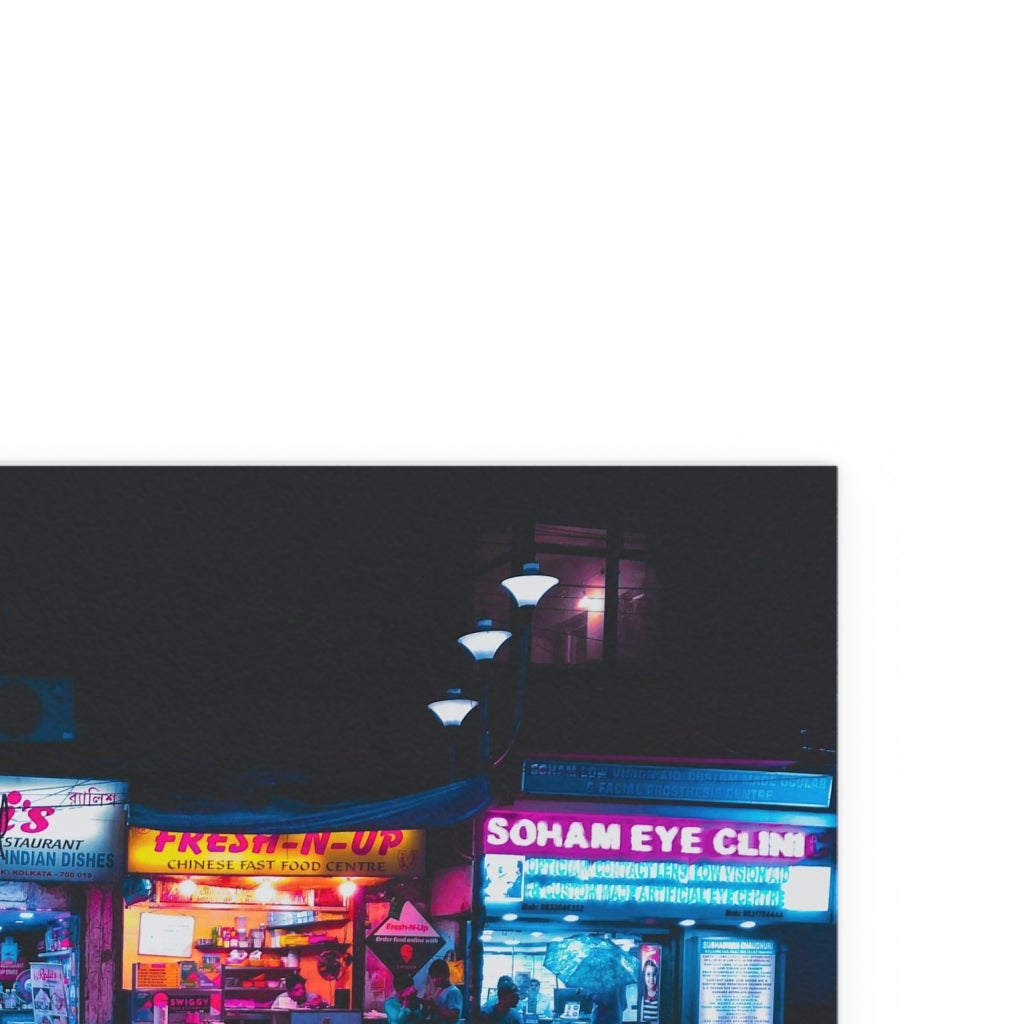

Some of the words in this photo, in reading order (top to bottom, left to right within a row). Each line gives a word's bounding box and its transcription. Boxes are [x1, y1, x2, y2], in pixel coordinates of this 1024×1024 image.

[154, 829, 404, 856] FRESH-N-UP
[487, 817, 622, 850] SOHAM
[631, 824, 703, 854] EYE
[6, 850, 56, 867] INDIAN
[61, 851, 114, 869] DISHES
[167, 859, 234, 870] CHINESE
[240, 860, 275, 871] FAST
[281, 860, 321, 872] FOOD
[325, 861, 385, 873] CENTRE
[12, 869, 52, 877] KOLKATA
[724, 865, 766, 883] VISION
[386, 923, 429, 933] Fresh-N-Up
[170, 998, 209, 1007] SWIGGY
